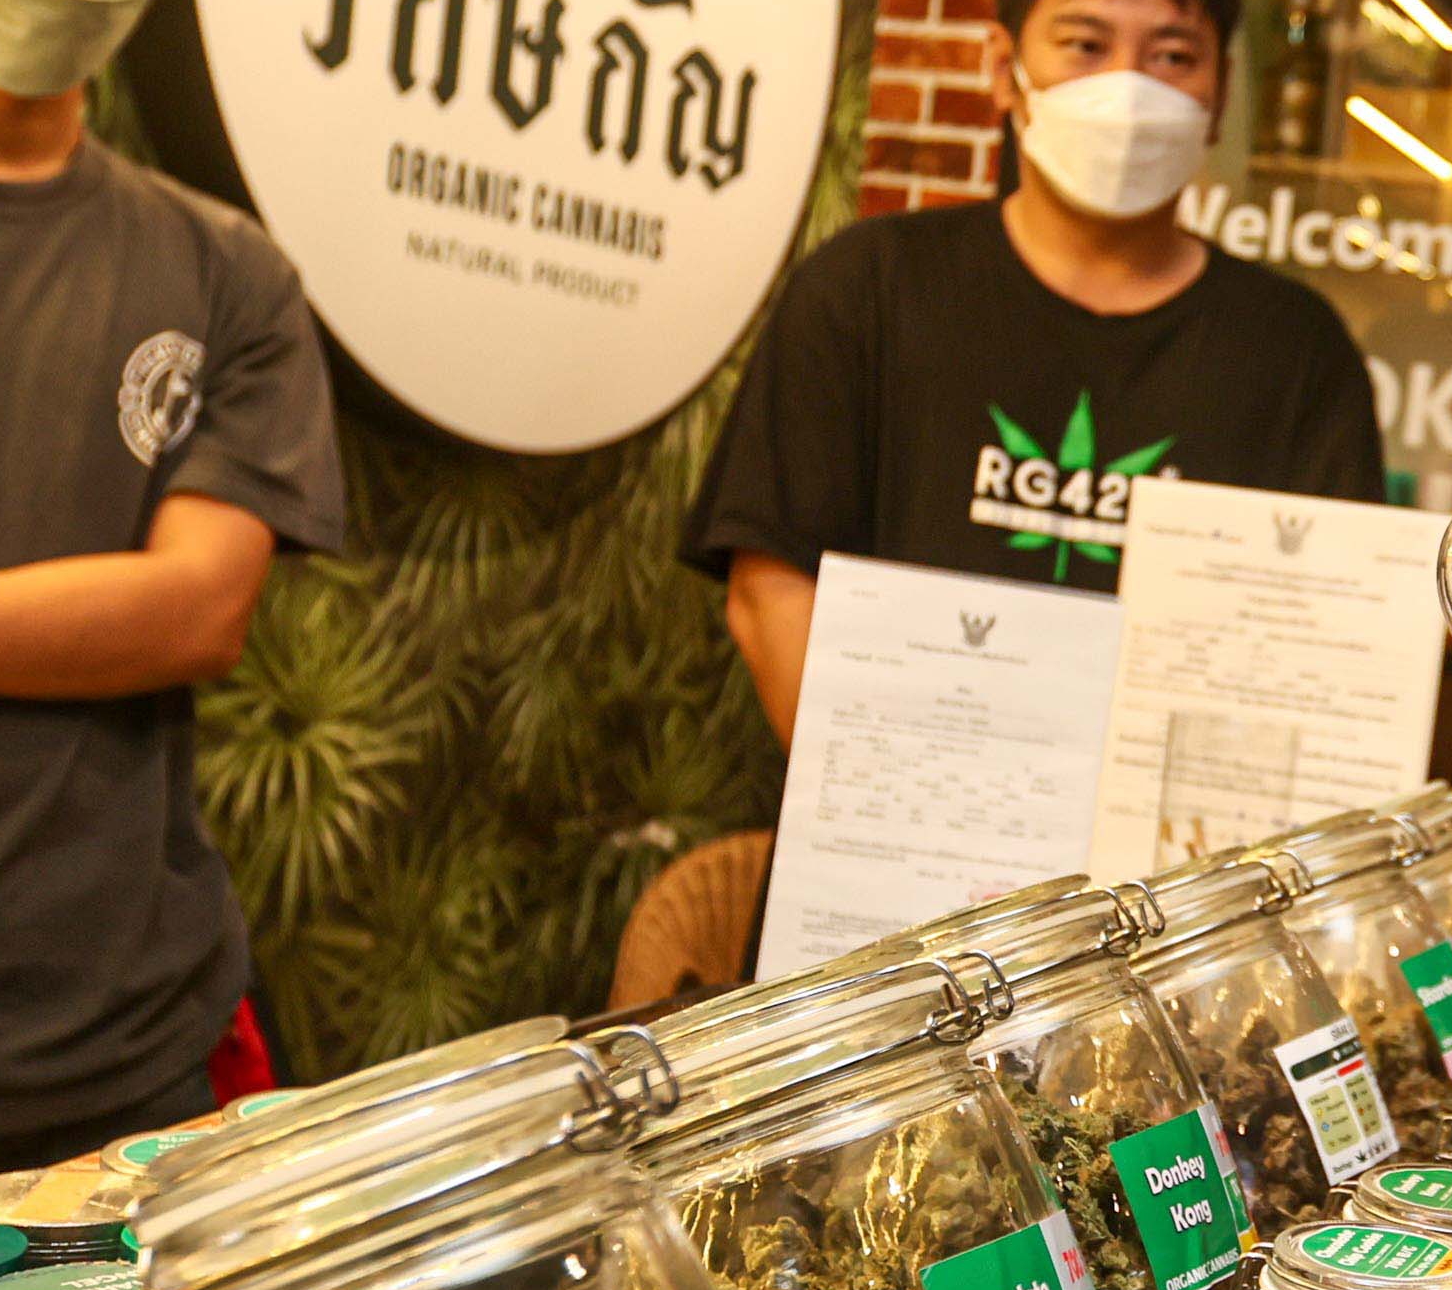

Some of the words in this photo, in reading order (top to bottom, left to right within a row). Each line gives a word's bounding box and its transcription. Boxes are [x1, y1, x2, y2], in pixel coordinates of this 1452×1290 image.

[386, 141, 522, 224] ORGANIC
[531, 181, 667, 262] CANNABIS
[406, 230, 523, 285] NATURAL
[531, 258, 640, 308] PRODUCT
[974, 445, 1129, 521] RG42
[1144, 1154, 1206, 1196] Donkey
[1169, 1198, 1214, 1233] Kong
